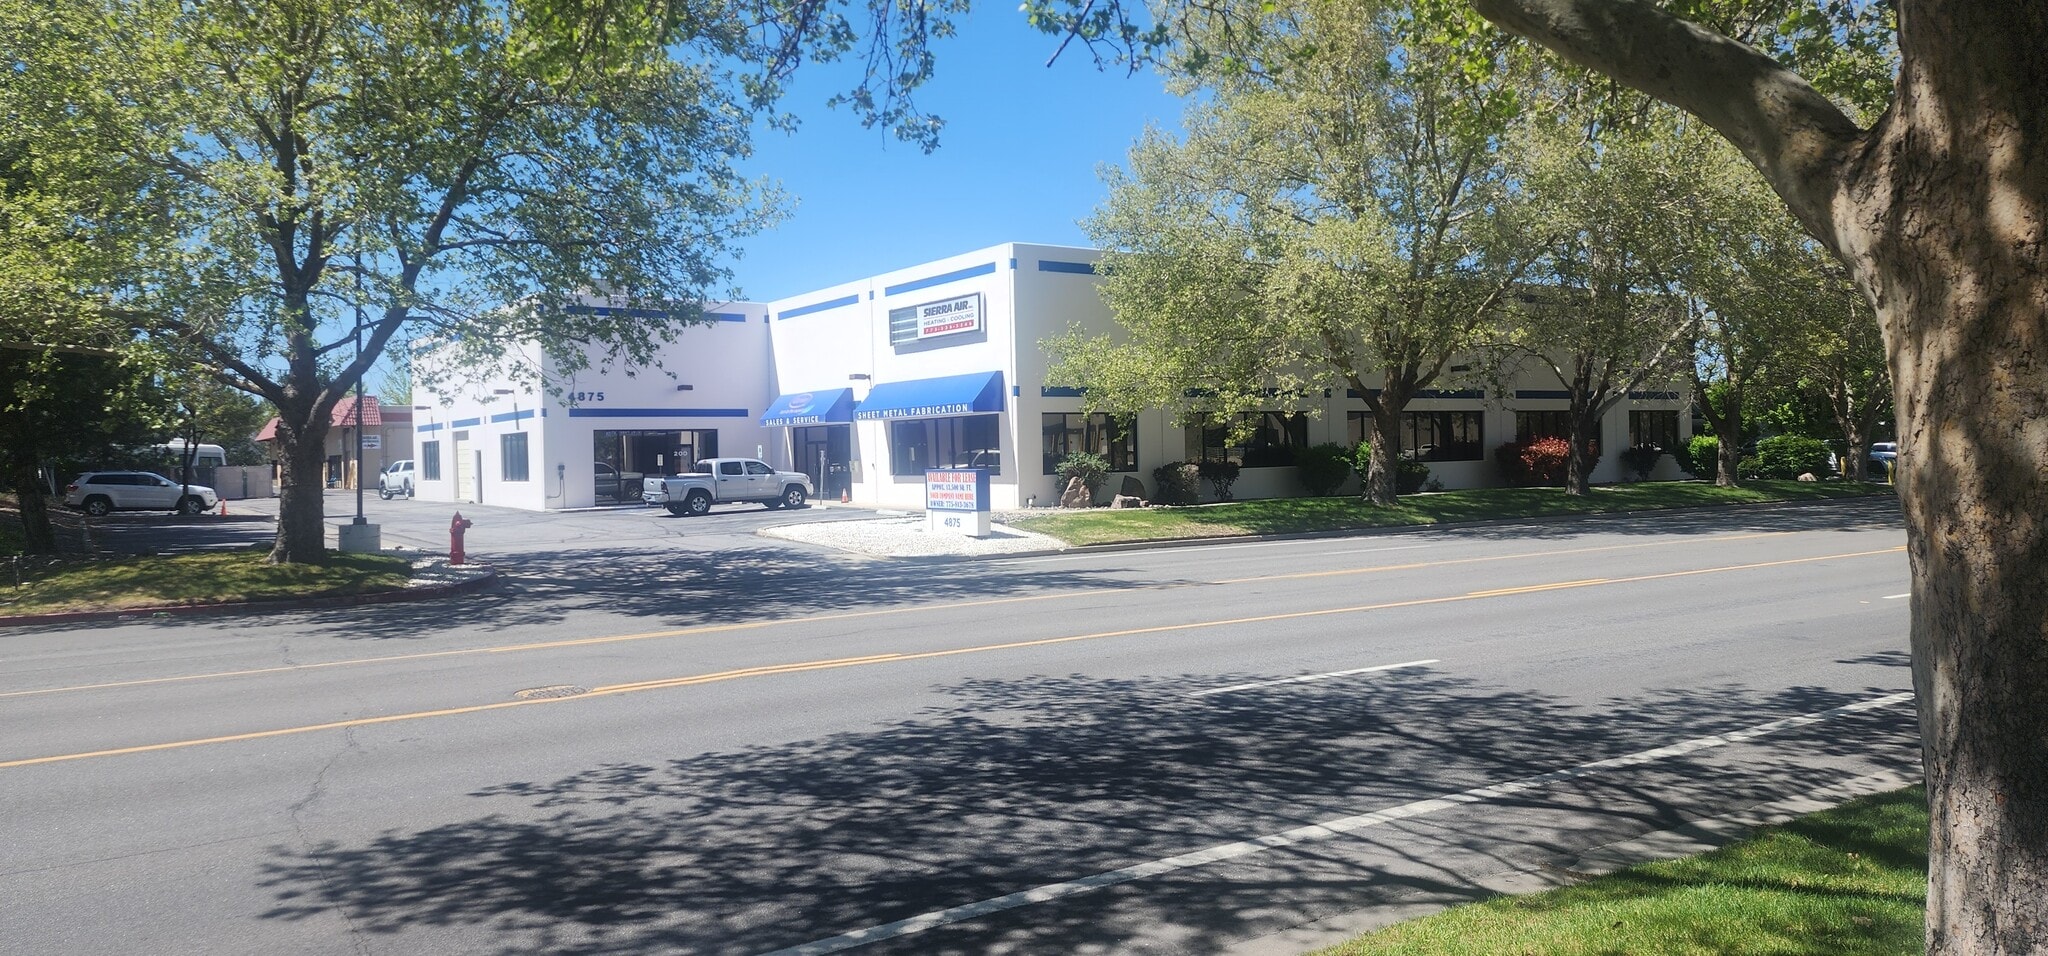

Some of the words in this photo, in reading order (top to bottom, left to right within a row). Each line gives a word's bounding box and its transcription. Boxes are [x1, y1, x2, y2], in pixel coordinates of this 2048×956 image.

[924, 304, 952, 318] SIERRA
[954, 300, 968, 312] AIR
[924, 318, 946, 326] HEATING
[950, 312, 974, 322] COOLING
[568, 392, 604, 402] 4875
[858, 411, 880, 419] SHEET
[883, 409, 907, 418] METAL
[911, 404, 968, 416] FABRICATION
[793, 416, 818, 424] SERVICE
[928, 472, 950, 482] AVAILABLE
[952, 472, 961, 482] FOR
[962, 472, 976, 483] LEASE
[944, 517, 960, 528] 4875
